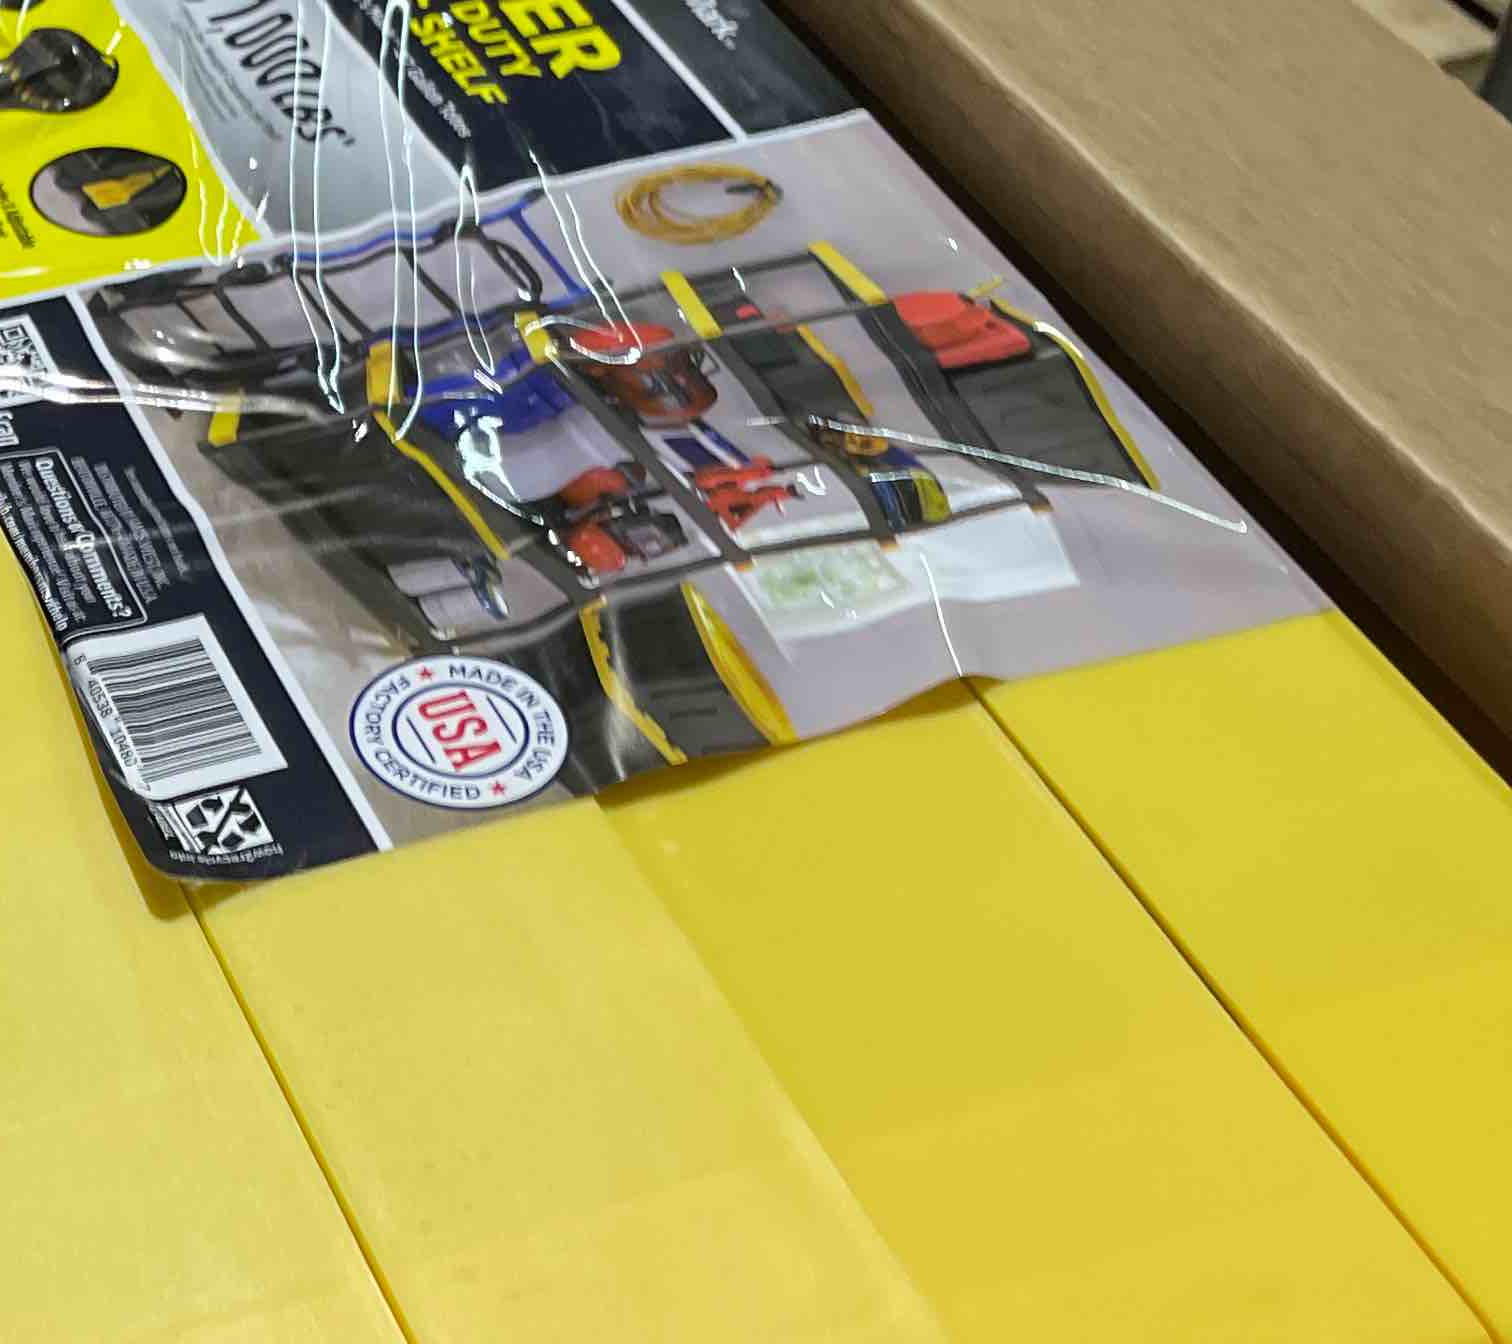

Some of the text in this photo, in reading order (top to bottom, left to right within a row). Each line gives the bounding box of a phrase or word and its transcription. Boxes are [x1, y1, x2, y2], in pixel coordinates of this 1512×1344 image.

[409, 12, 509, 105] SHELF
[36, 457, 78, 524] Questions
[75, 529, 133, 619] Comments?
[364, 676, 481, 801] FACTORY CERTIFIED
[417, 688, 502, 773] USA
[449, 663, 556, 782] MADE IN THE USA
